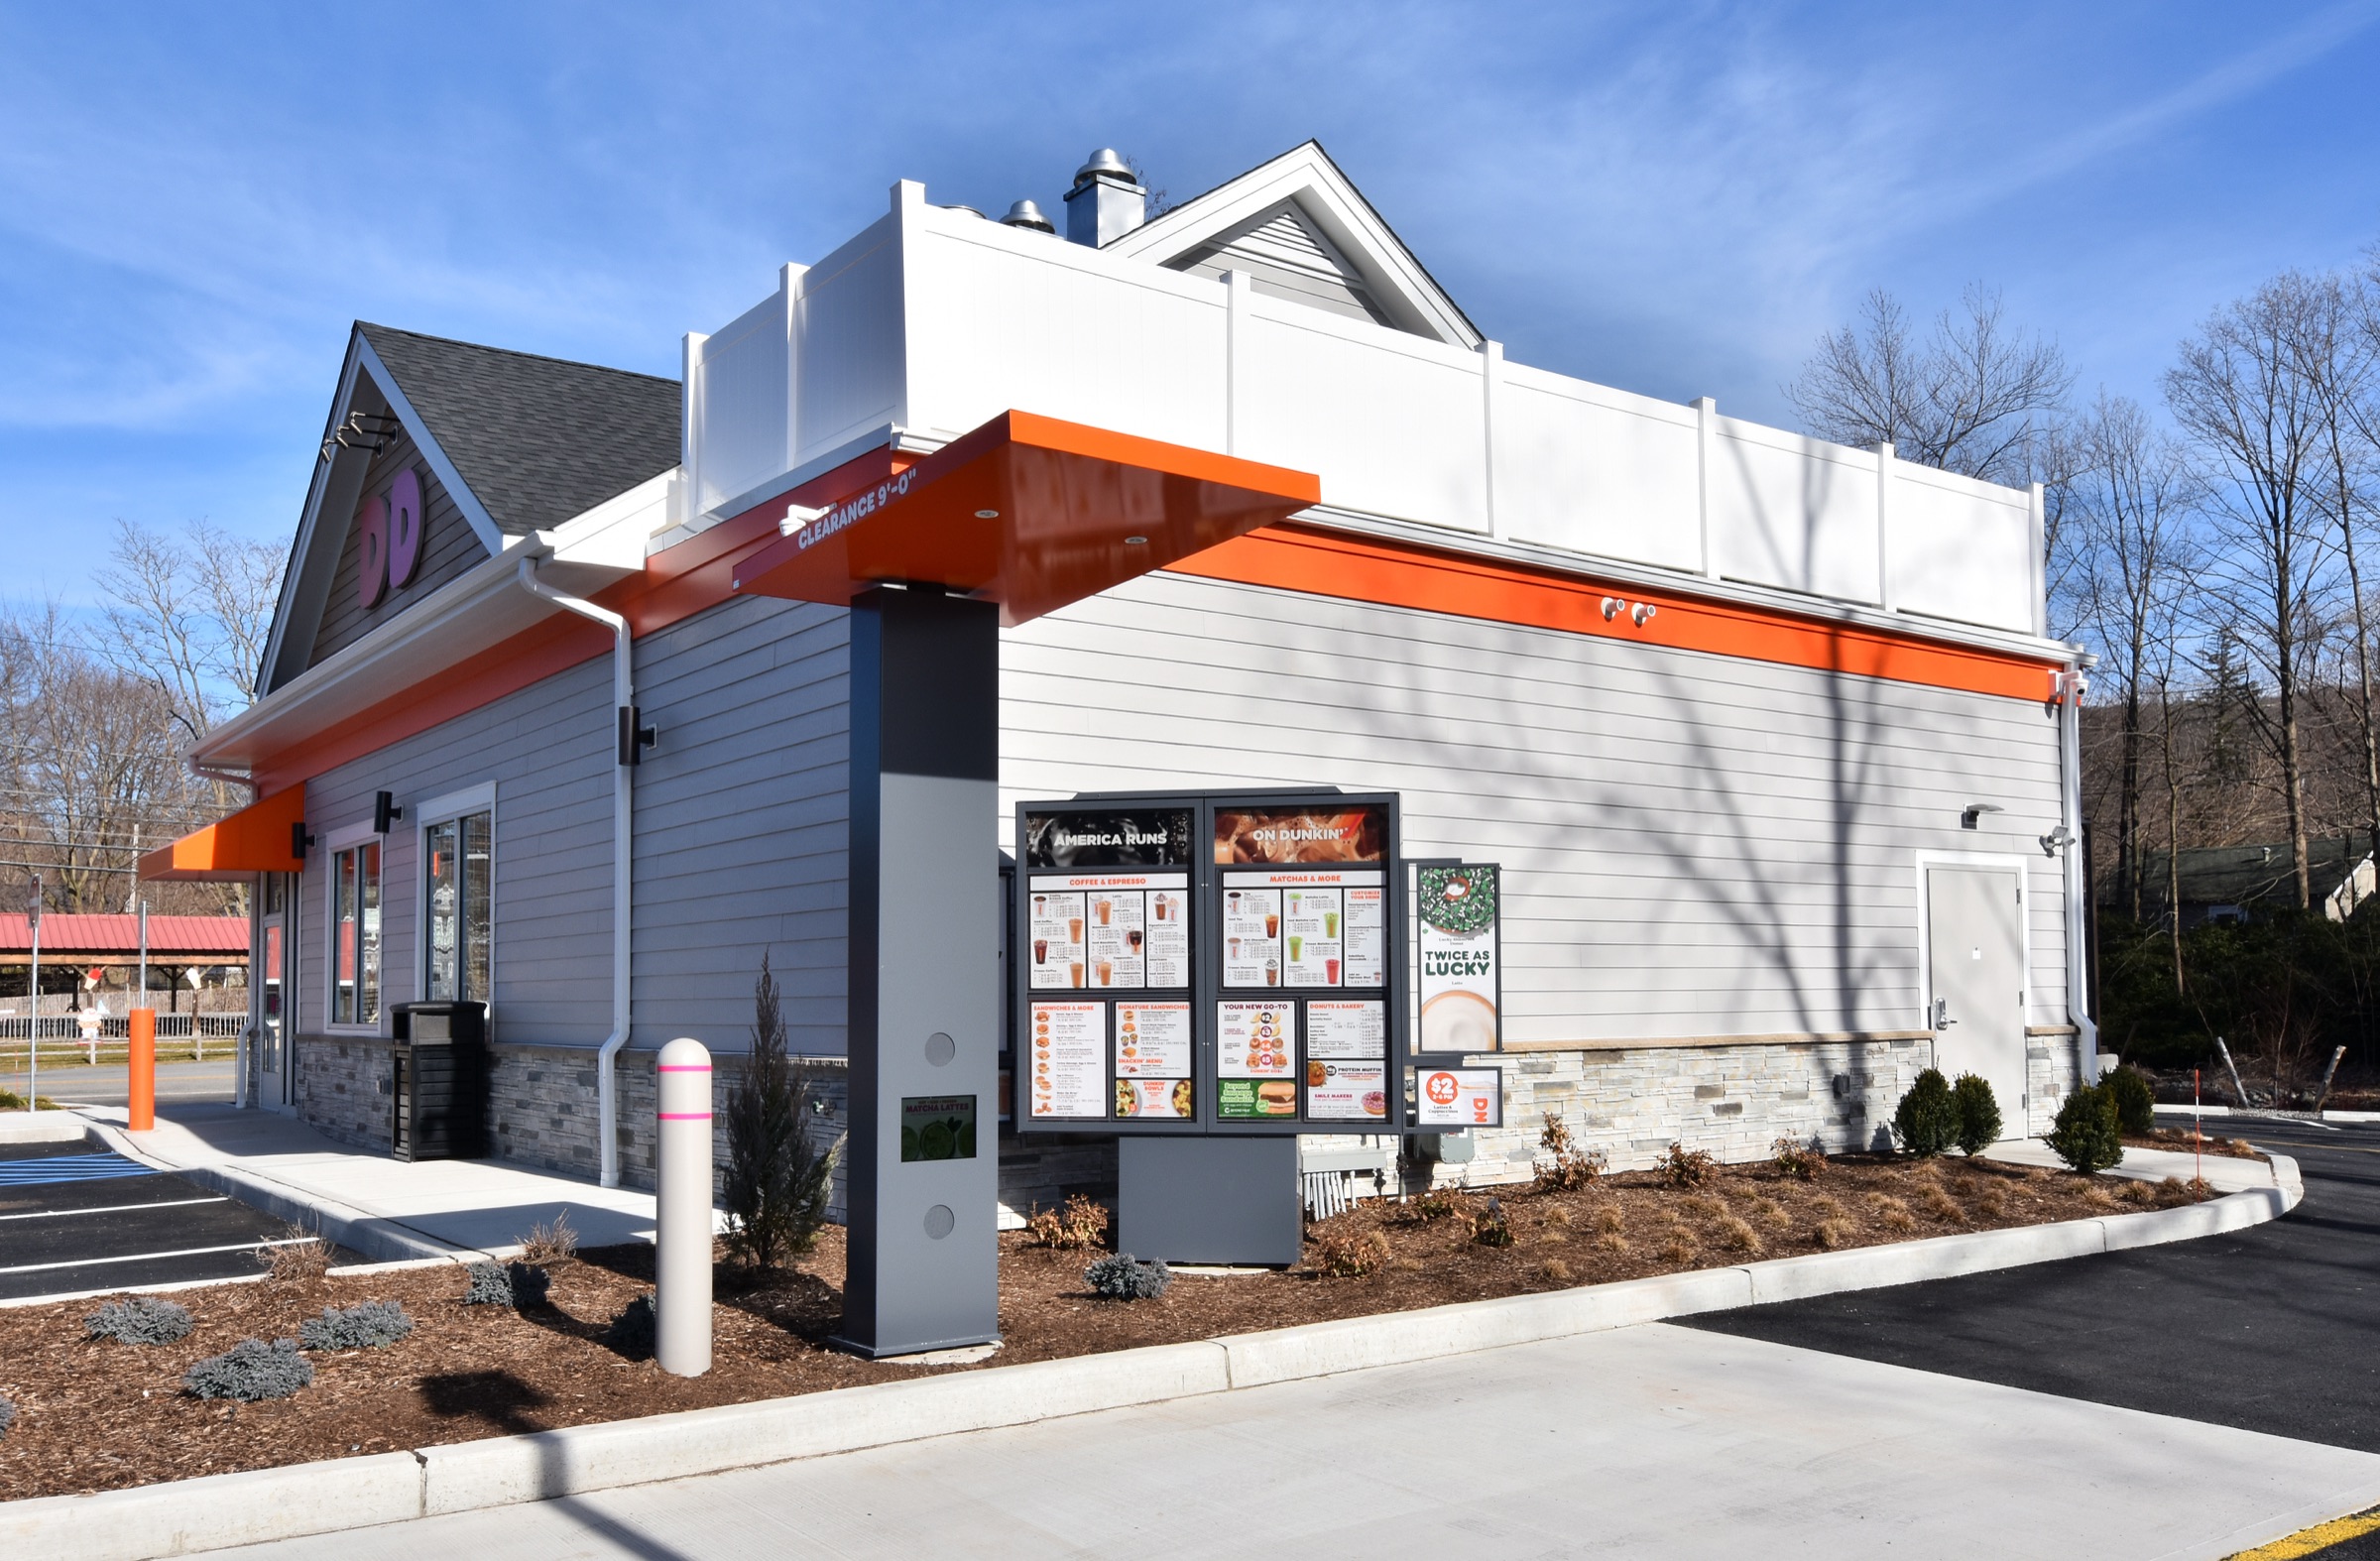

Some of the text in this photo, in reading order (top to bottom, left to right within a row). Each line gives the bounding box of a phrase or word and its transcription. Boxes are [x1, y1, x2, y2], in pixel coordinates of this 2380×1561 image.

[798, 492, 875, 549] CLEARANCE
[1054, 833, 1168, 847] AMERICA RUNS
[1252, 830, 1276, 842] ON
[1425, 950, 1489, 961] TWICE AS
[1425, 962, 1490, 976] LUCKY
[1431, 1078, 1454, 1094] $2
[905, 1104, 940, 1113] MATCHA
